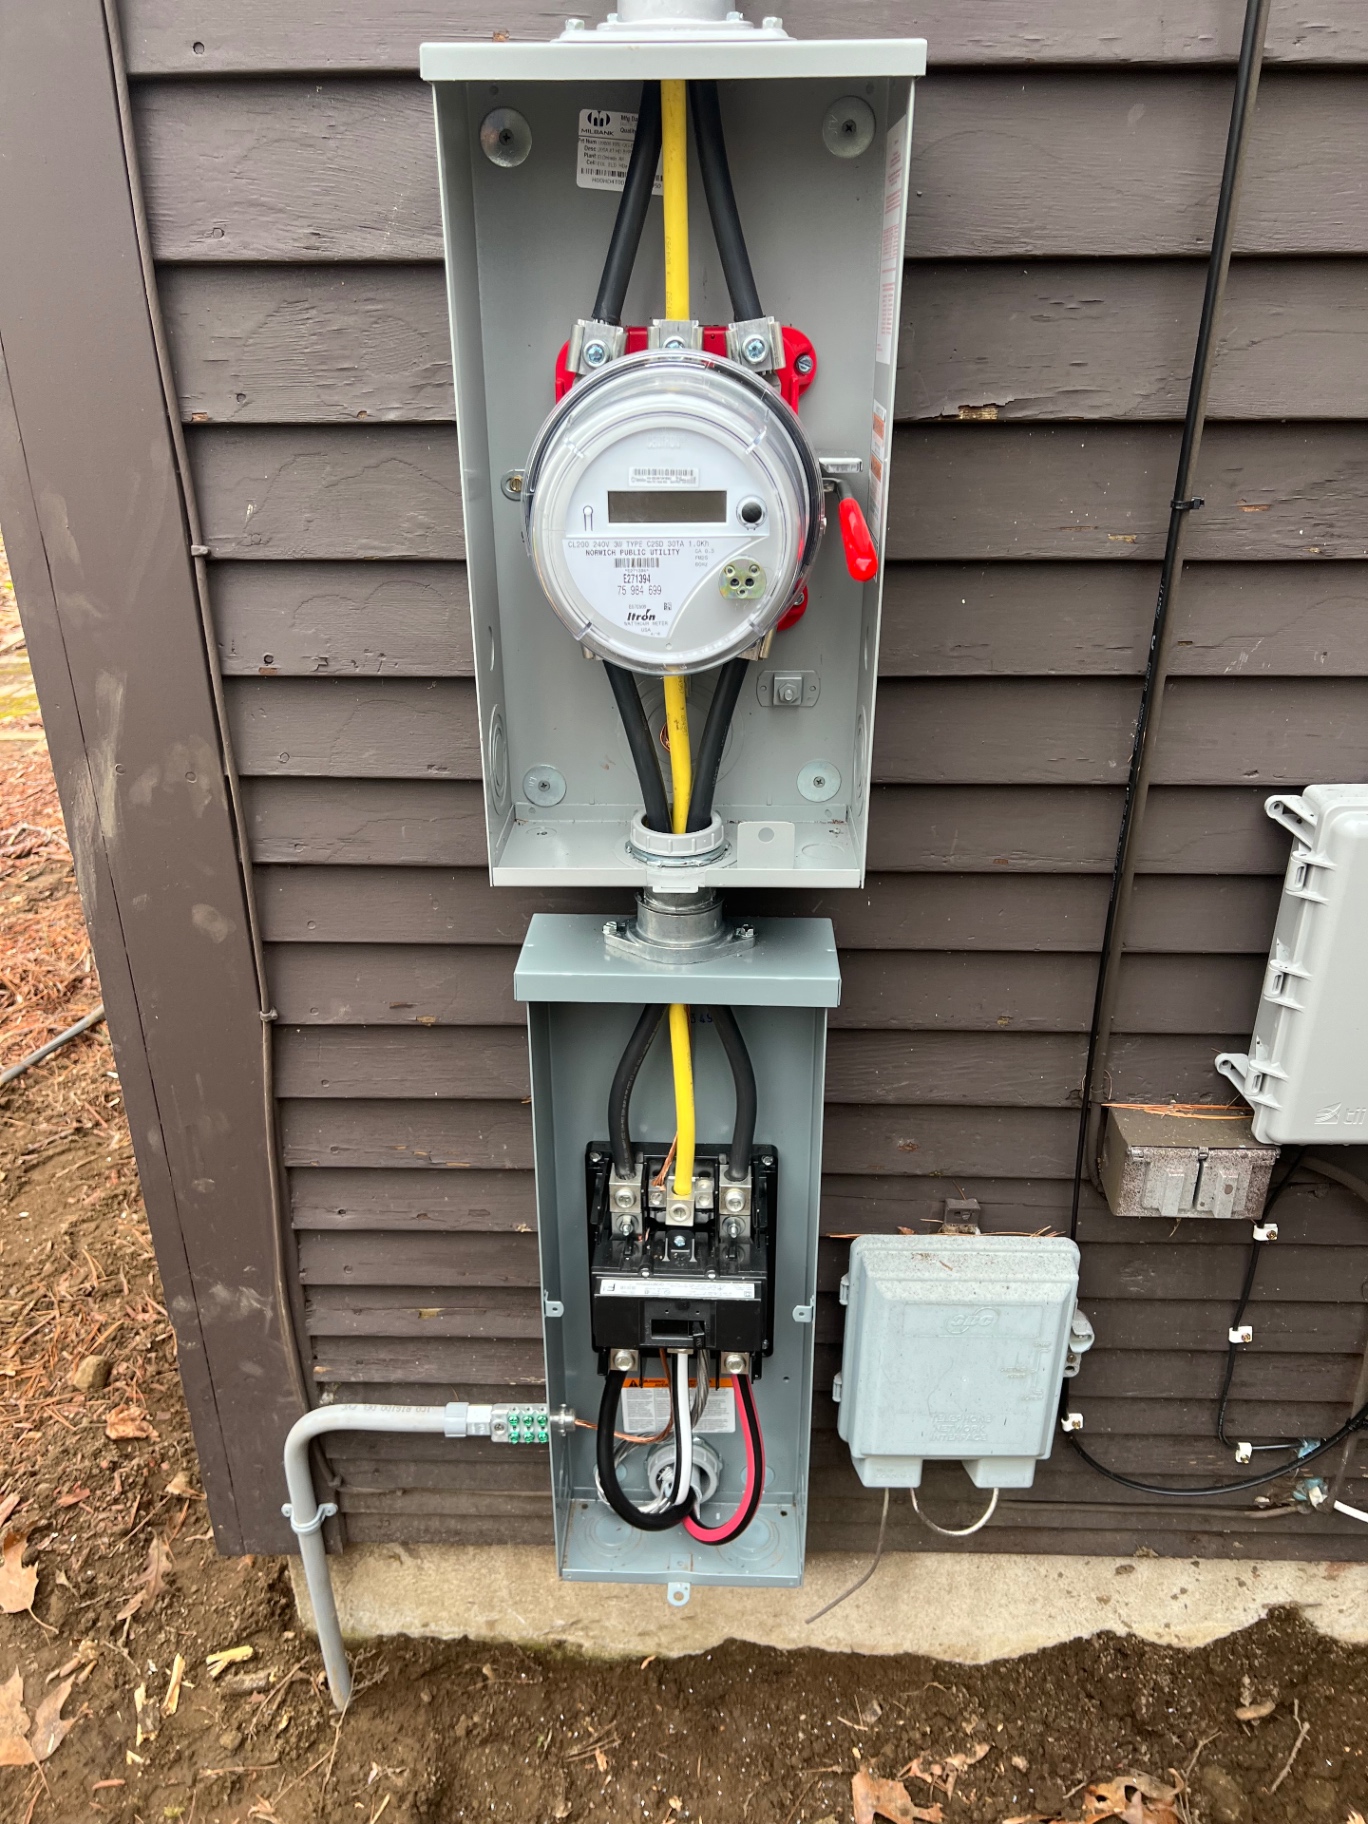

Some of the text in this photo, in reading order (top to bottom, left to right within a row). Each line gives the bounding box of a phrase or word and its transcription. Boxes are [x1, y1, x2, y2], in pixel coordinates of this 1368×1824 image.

[581, 128, 615, 136] MILBANK
[623, 573, 651, 584] E271394
[617, 585, 662, 595] 75 984 699
[627, 609, 656, 621] Itron
[931, 1413, 993, 1423] TELEPHONE
[932, 1424, 986, 1433] NETWORK
[930, 1433, 989, 1442] INTERFACE
